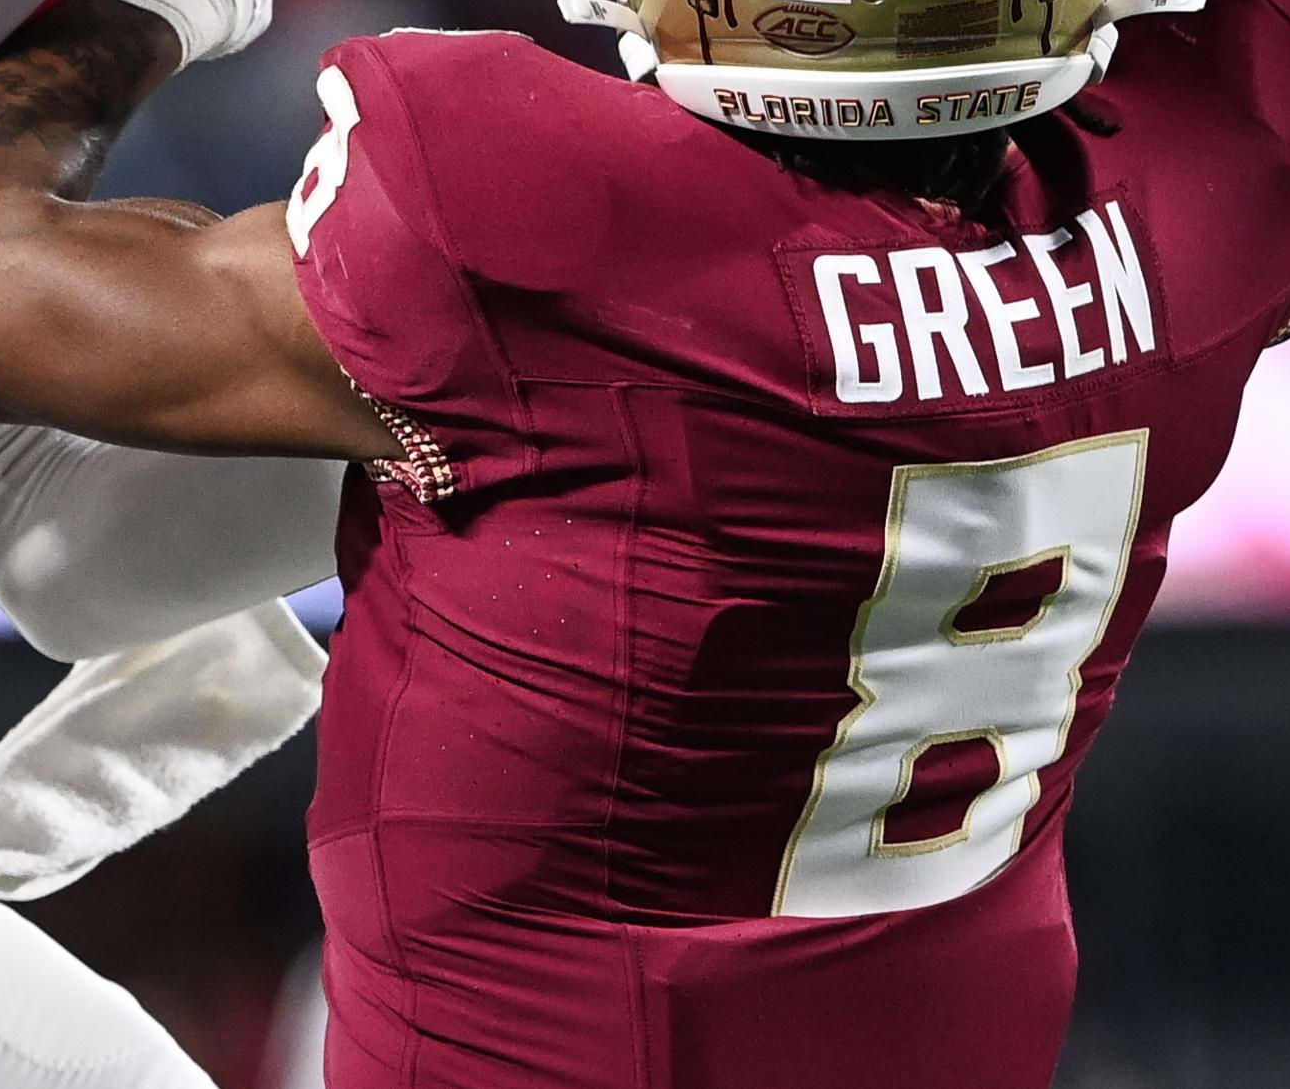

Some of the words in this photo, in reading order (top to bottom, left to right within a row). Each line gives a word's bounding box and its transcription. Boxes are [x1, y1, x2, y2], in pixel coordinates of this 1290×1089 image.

[713, 88, 895, 128] FLORIDA
[916, 81, 1042, 126] STATE
[766, 17, 842, 38] ACC
[285, 64, 361, 259] 8
[812, 200, 1157, 404] GREEN
[770, 427, 1150, 919] 8
